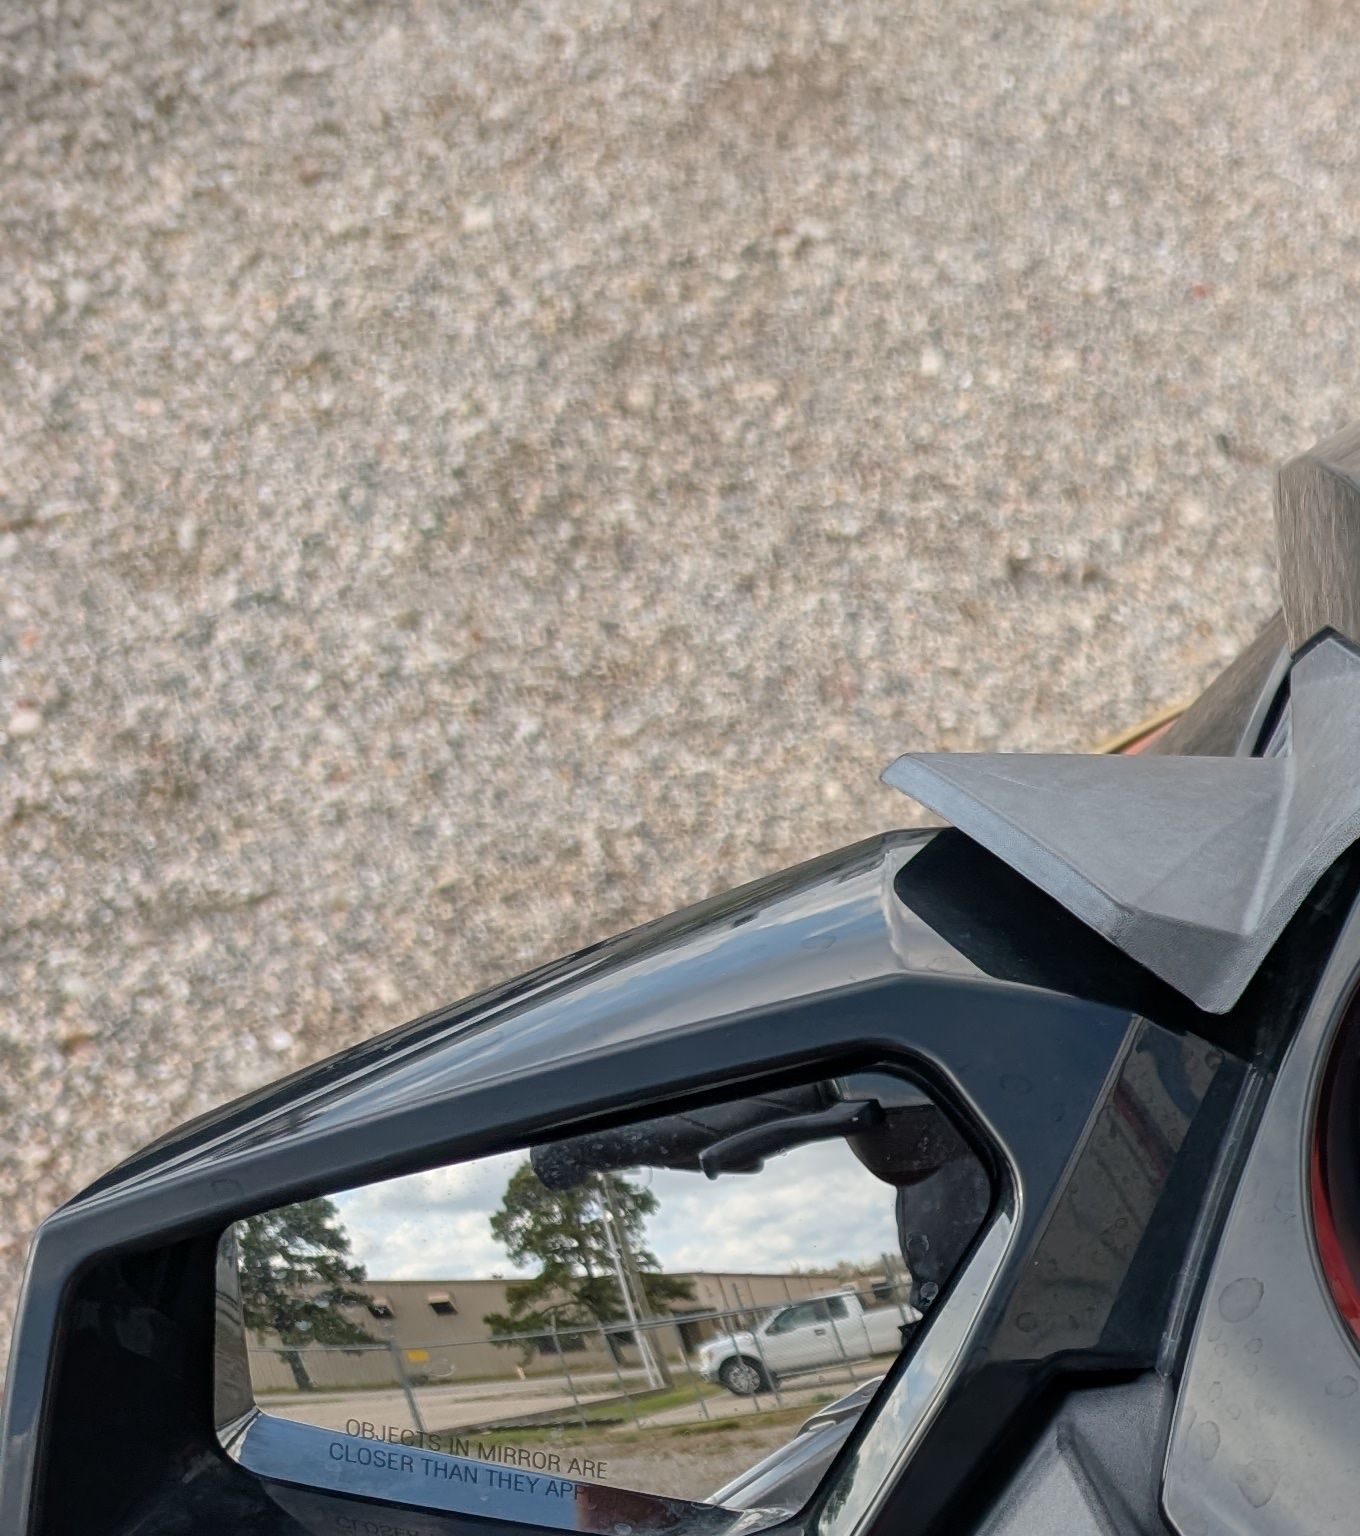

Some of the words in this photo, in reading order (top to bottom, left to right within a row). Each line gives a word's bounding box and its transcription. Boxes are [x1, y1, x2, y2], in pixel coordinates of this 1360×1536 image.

[328, 1442, 414, 1473] CLOSER
[421, 1457, 478, 1485] THAN
[487, 1469, 540, 1493] THEY
[345, 1418, 442, 1451] OBJECTS
[449, 1436, 471, 1457] IN
[478, 1442, 561, 1473] MIRROR
[567, 1456, 608, 1480] ARE
